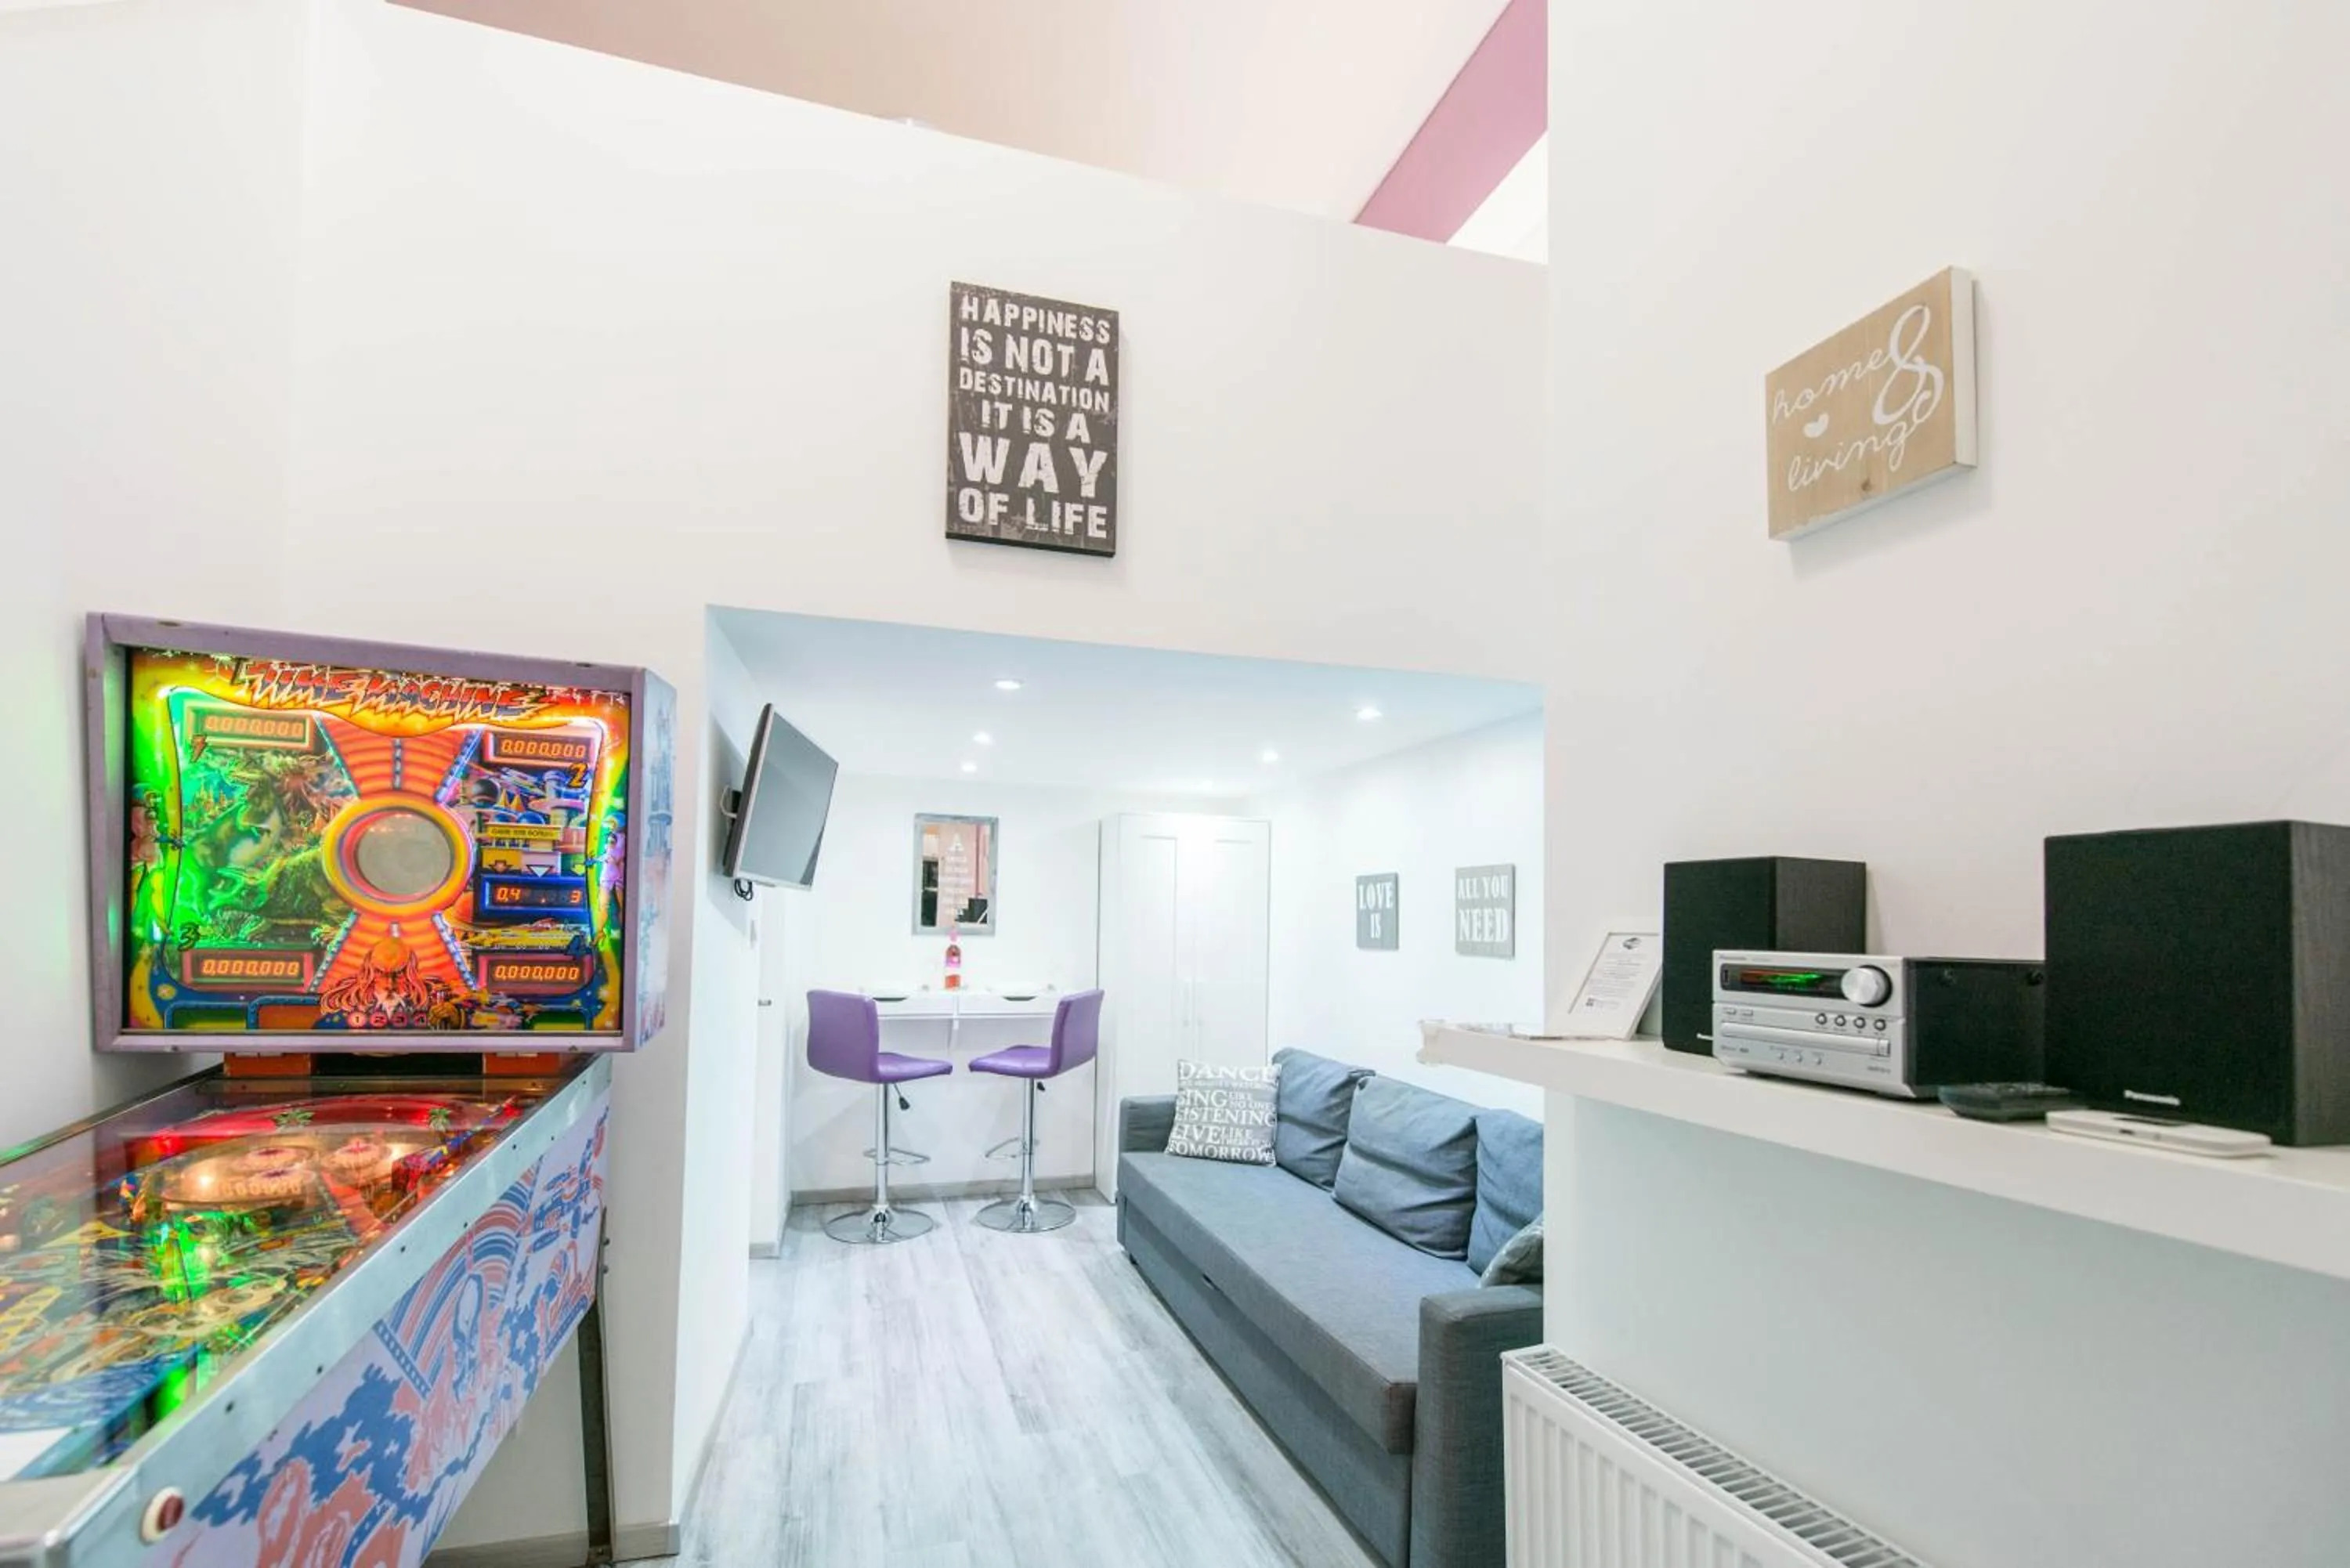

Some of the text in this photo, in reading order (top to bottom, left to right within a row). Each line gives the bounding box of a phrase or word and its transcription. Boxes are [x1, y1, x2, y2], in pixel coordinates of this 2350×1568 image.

[961, 294, 1111, 344] HAPPINESS
[960, 327, 1109, 385] IS NOT A
[960, 367, 1109, 412] DESTINATION
[1772, 349, 1890, 424] home
[982, 400, 1090, 443] IT IS A
[958, 432, 1108, 498] WAY
[1788, 421, 1919, 491] living
[958, 487, 1107, 538] OF LIFE
[568, 761, 588, 788] 2
[1358, 881, 1393, 910] LOVE
[1458, 875, 1509, 900] ALL YOU
[1371, 912, 1381, 938] IS
[1459, 907, 1509, 942] NEED
[1180, 1062, 1276, 1081] DANCE
[1177, 1089, 1227, 1107] SING
